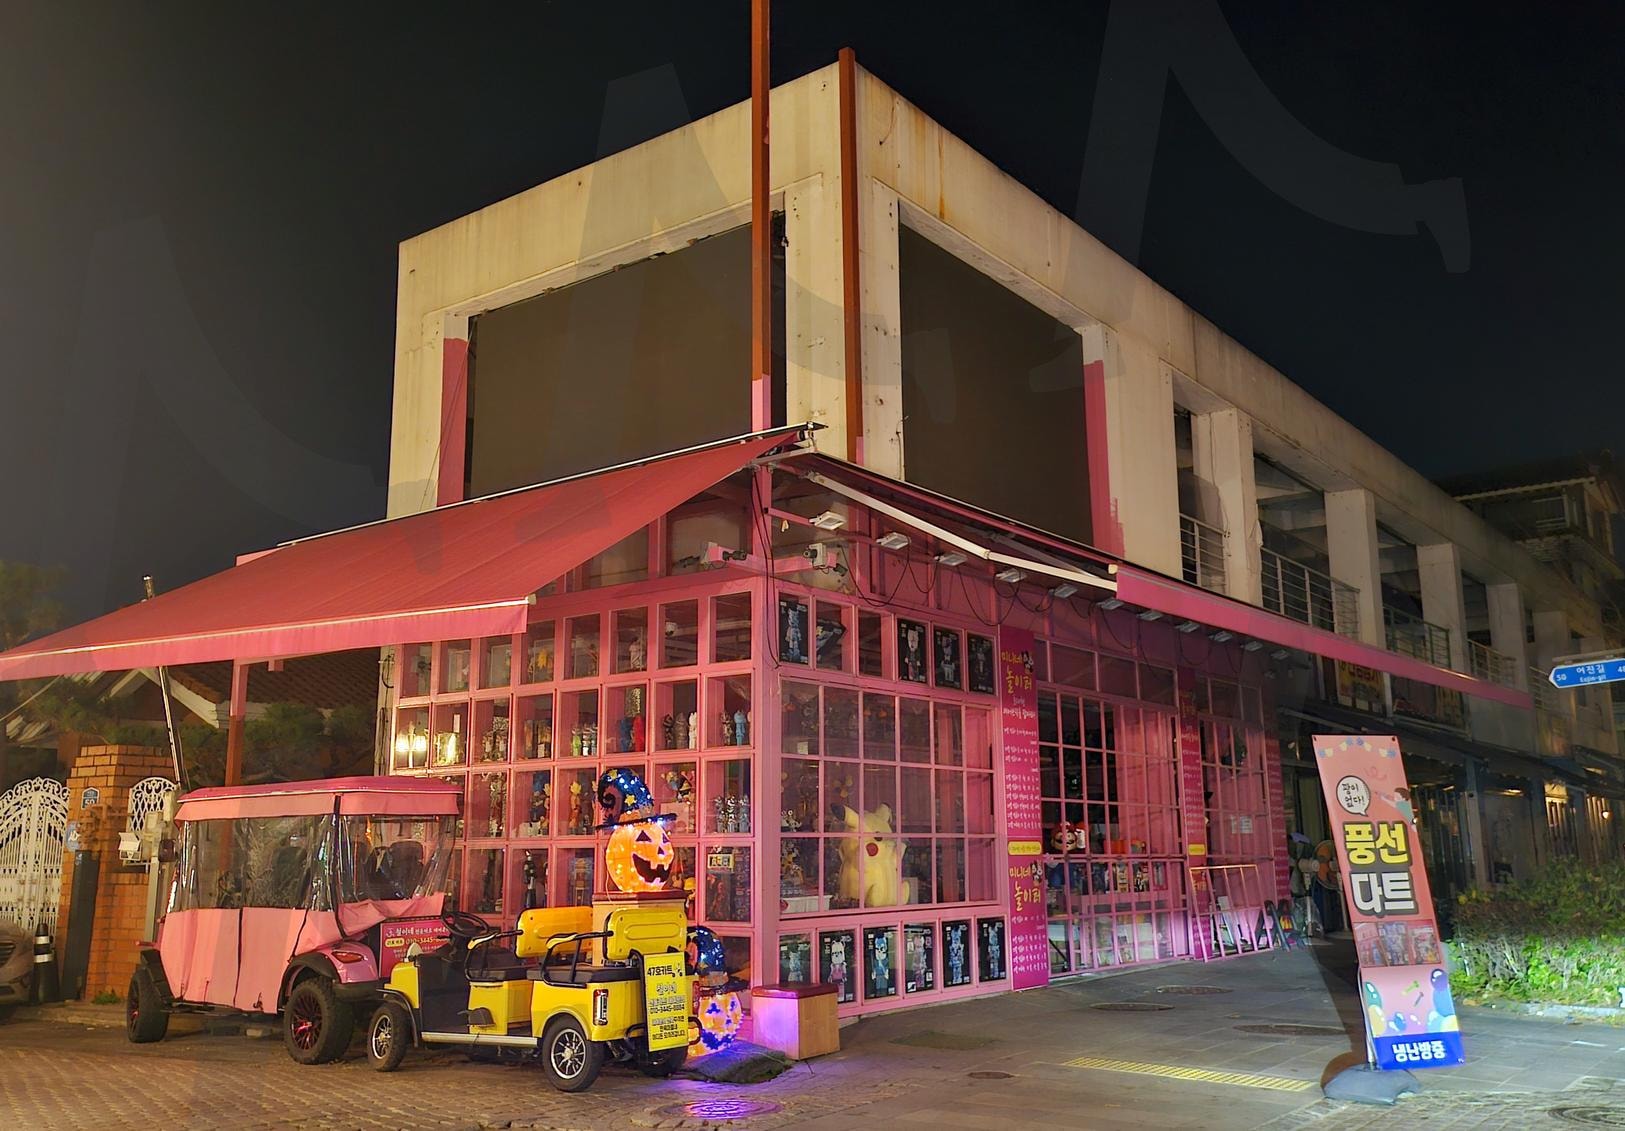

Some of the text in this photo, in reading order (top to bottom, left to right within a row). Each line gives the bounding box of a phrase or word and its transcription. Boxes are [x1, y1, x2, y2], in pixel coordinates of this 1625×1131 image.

[1005, 666, 1033, 695] 놀이터
[1576, 664, 1606, 675] 어진길
[1343, 823, 1409, 866] 풍선
[1009, 866, 1031, 878] 미니네
[1014, 881, 1041, 912] 놀이터
[1350, 871, 1415, 914] 다트
[1391, 1040, 1447, 1063] 냉난방중
